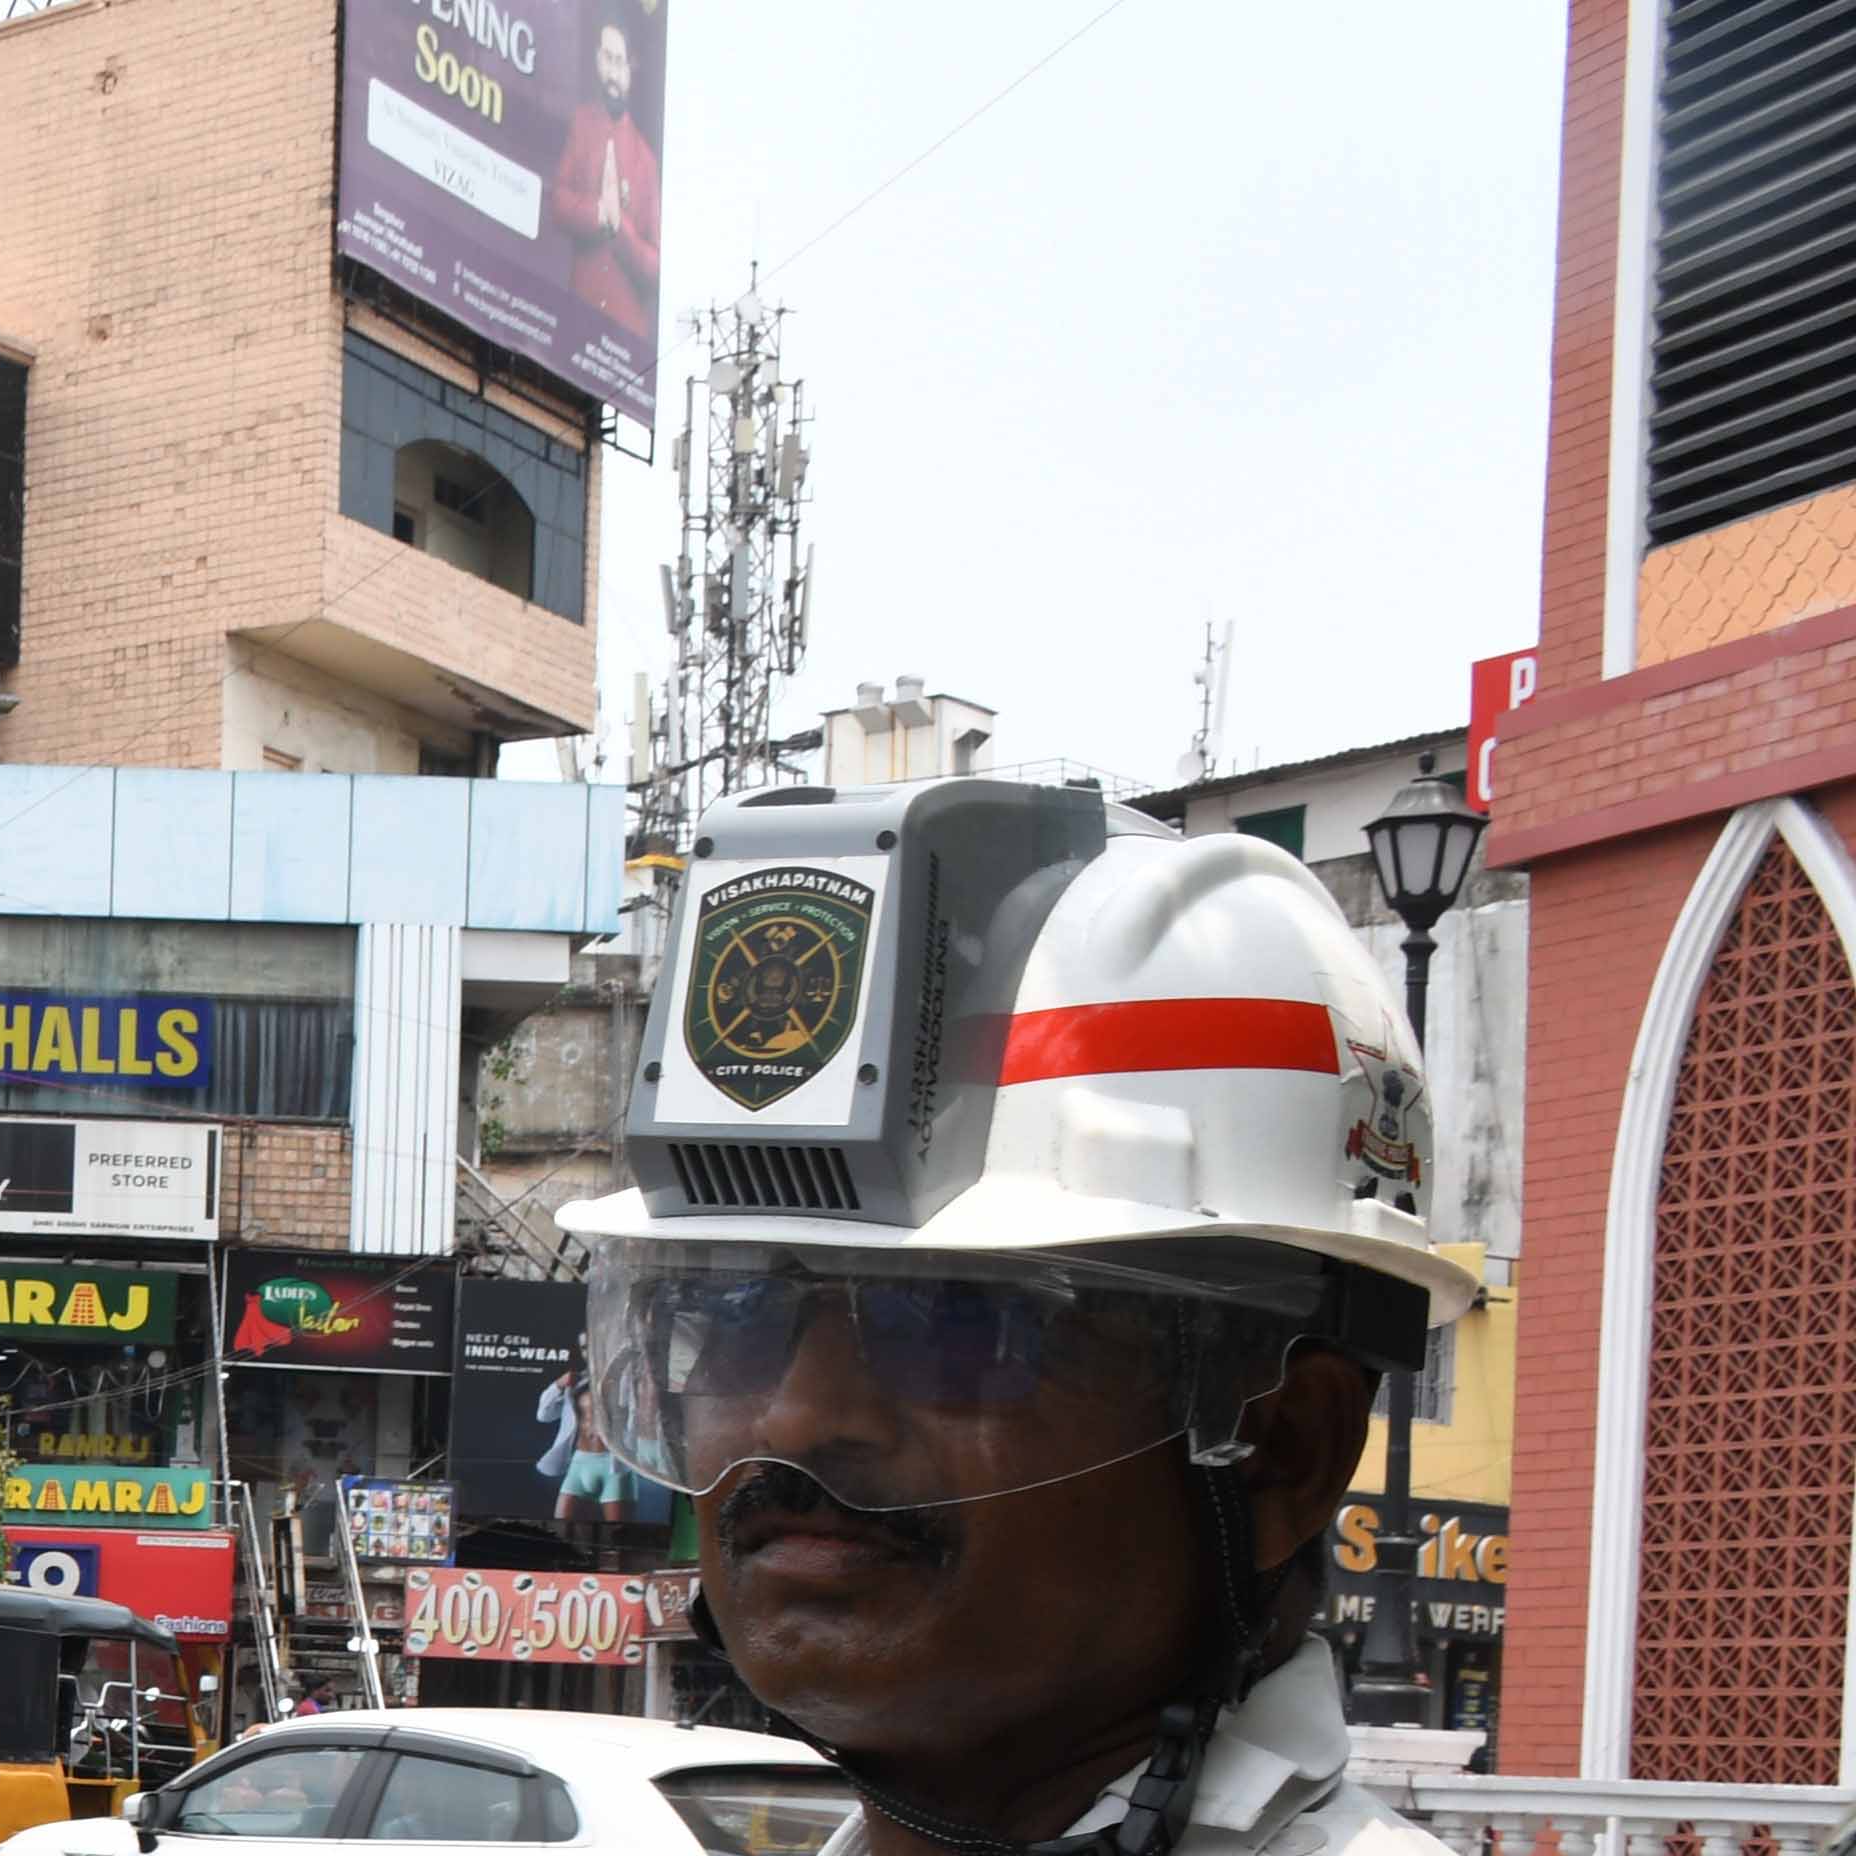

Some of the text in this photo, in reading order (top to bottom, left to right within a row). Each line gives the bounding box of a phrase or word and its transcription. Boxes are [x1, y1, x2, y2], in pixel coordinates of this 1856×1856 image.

[416, 24, 503, 124] Soon
[706, 872, 869, 907] VISAKHAPATNAM
[715, 1064, 804, 1078] CITY POLICE
[88, 1153, 193, 1171] PREFERRED
[111, 1173, 169, 1190] STORE
[466, 1333, 530, 1345] NEXT GEN
[465, 1345, 570, 1362] INNO-WEAR
[5, 1477, 206, 1516] RAMRAJ
[1333, 1504, 1509, 1584] Sike
[154, 1614, 228, 1634] Fashions
